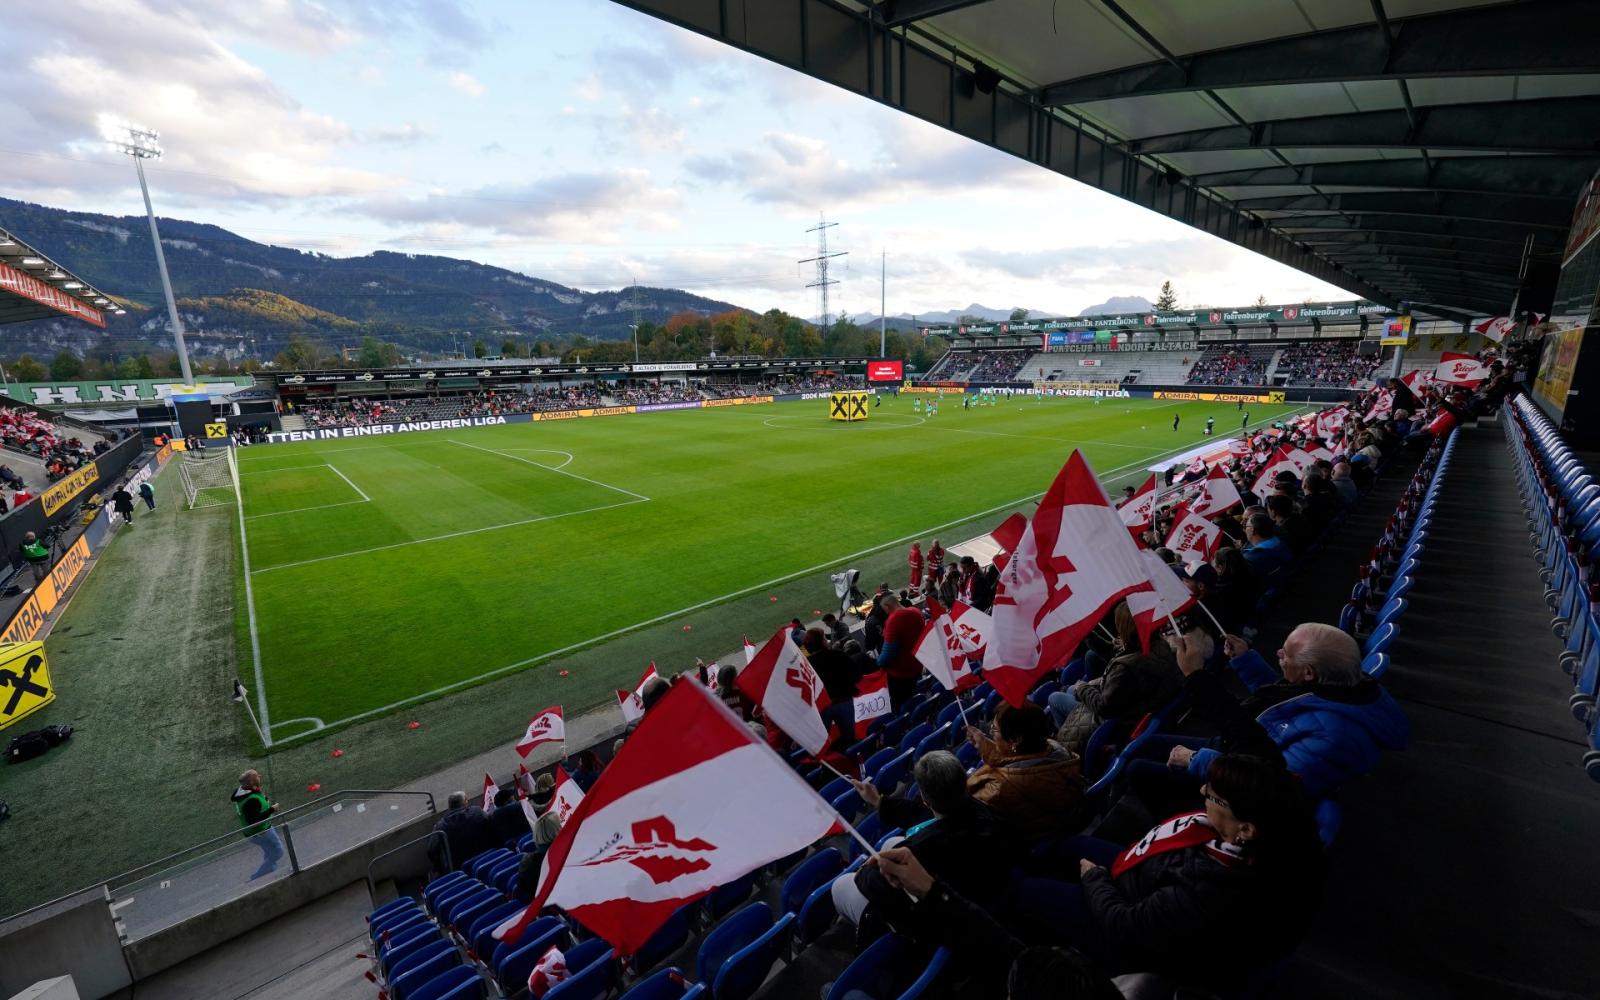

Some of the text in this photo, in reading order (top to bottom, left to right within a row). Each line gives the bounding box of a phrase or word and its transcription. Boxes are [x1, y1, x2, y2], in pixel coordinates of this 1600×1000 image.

[267, 416, 506, 443] TTEN IN EINER ANDEREN LIGA
